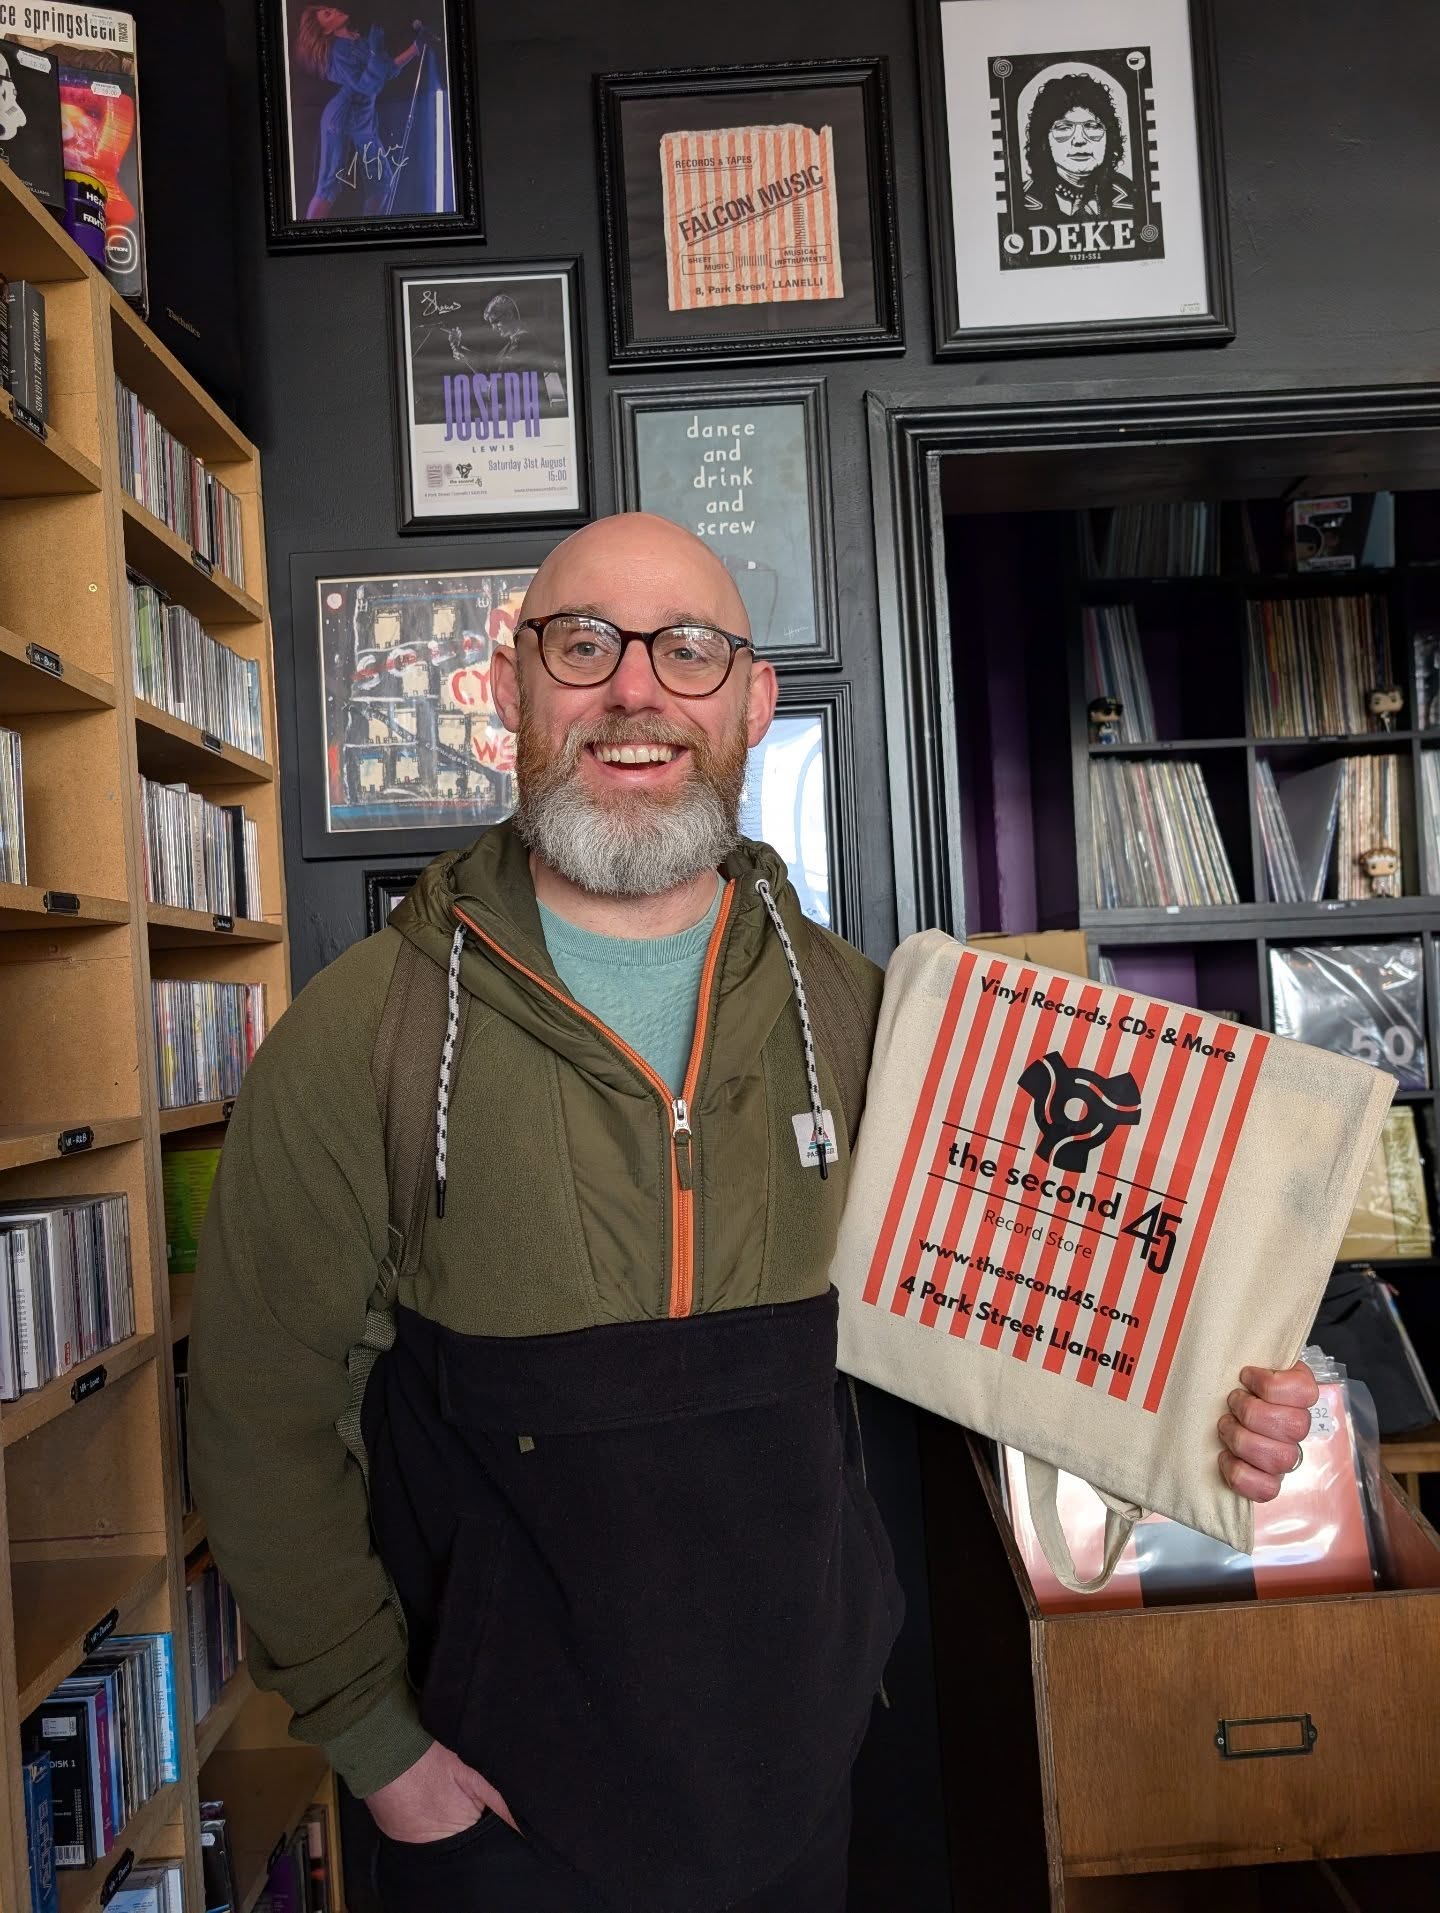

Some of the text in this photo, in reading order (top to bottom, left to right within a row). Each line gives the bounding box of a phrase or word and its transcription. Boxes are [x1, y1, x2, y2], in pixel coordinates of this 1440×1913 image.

[24, 7, 116, 42] springsteen
[118, 22, 129, 43] TRACKS
[675, 155, 752, 169] RECORDS & TAPES
[678, 194, 756, 242] FALCON
[757, 164, 824, 209] MUSIC
[1028, 219, 1135, 256] DEKE
[688, 256, 711, 264] SHEET
[774, 256, 827, 266] INSTRUMENTS
[784, 248, 818, 257] MUSICAL
[704, 263, 730, 271] MUSIC
[695, 287, 705, 296] 8,
[708, 284, 732, 295] Park
[772, 277, 823, 289] LLANELLI
[166, 306, 201, 339] Technics
[32, 308, 43, 414] AMERICAN JAZZ LEGENDS
[443, 371, 541, 442] JOSEPH
[687, 415, 755, 438] dance
[472, 444, 515, 454] LEWIS
[703, 438, 741, 463] and
[488, 457, 566, 472] Saturday 31st August
[548, 470, 567, 482] 15:00
[693, 465, 753, 489] drink
[706, 489, 744, 514] and
[696, 520, 756, 537] screw
[980, 976, 1236, 1063] Vinyl Records, CDs & More
[1352, 1024, 1416, 1068] 50
[948, 1142, 1183, 1275] the second 45
[984, 1209, 1092, 1259] Record Store
[919, 1239, 1140, 1329] www.thesecond45.com
[900, 1275, 1135, 1377] 4 Park Street Llanelli
[50, 1759, 76, 1769] DISK 1
